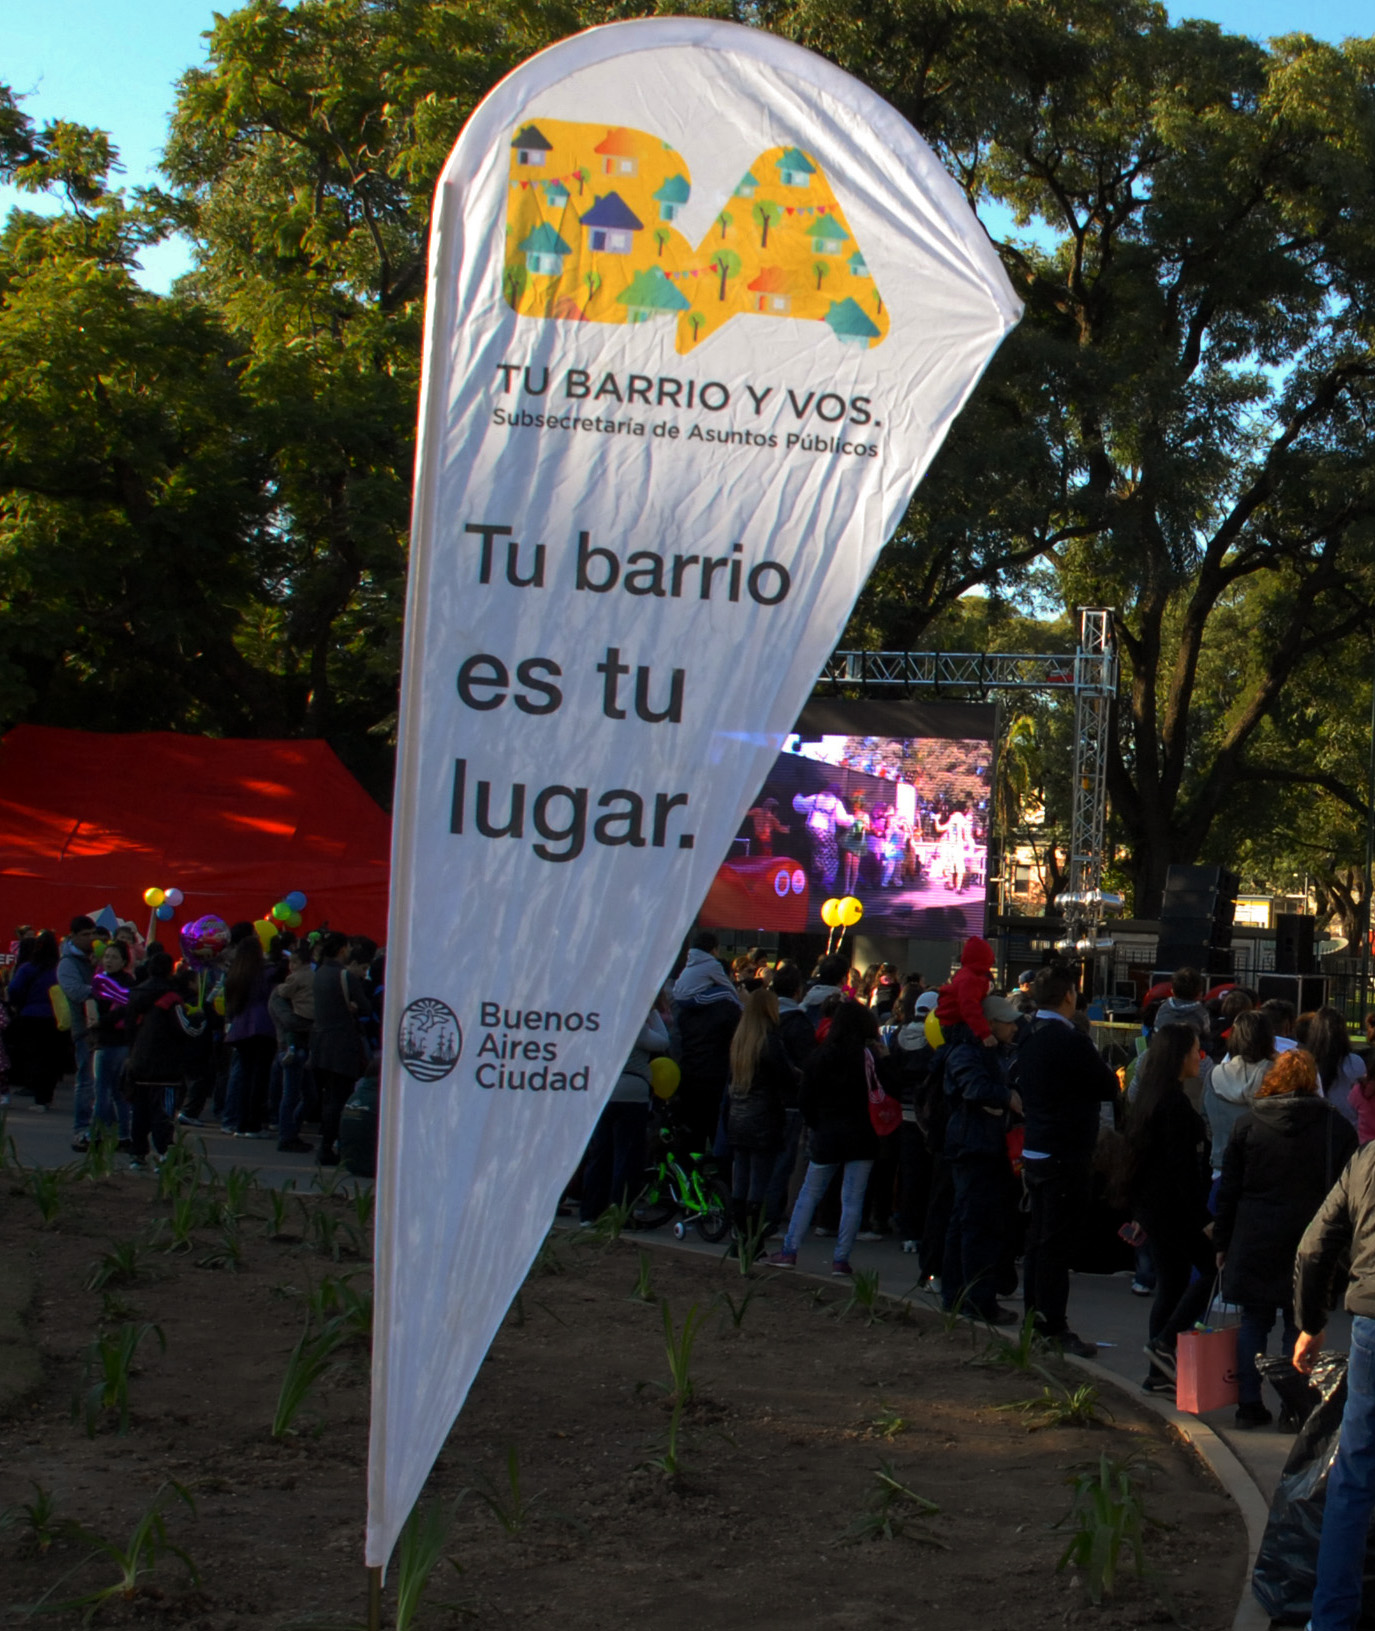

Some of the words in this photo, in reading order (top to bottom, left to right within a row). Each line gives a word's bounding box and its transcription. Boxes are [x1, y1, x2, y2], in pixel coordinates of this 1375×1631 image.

[496, 363, 549, 396] TU
[566, 368, 730, 412] BARRIO
[746, 384, 773, 416] Y
[787, 389, 882, 428] VOS.
[492, 408, 646, 436] Subsecretaría
[652, 420, 681, 439] de
[687, 424, 778, 448] Asuntos
[786, 432, 879, 458] Públicos
[465, 523, 546, 588] Tu
[575, 531, 791, 606] barrio
[456, 653, 563, 716] es
[597, 647, 685, 724] tu
[449, 758, 695, 863] lugar.
[480, 1001, 600, 1032] Buenos
[476, 1033, 558, 1061] Aires
[475, 1062, 590, 1091] Ciudad
